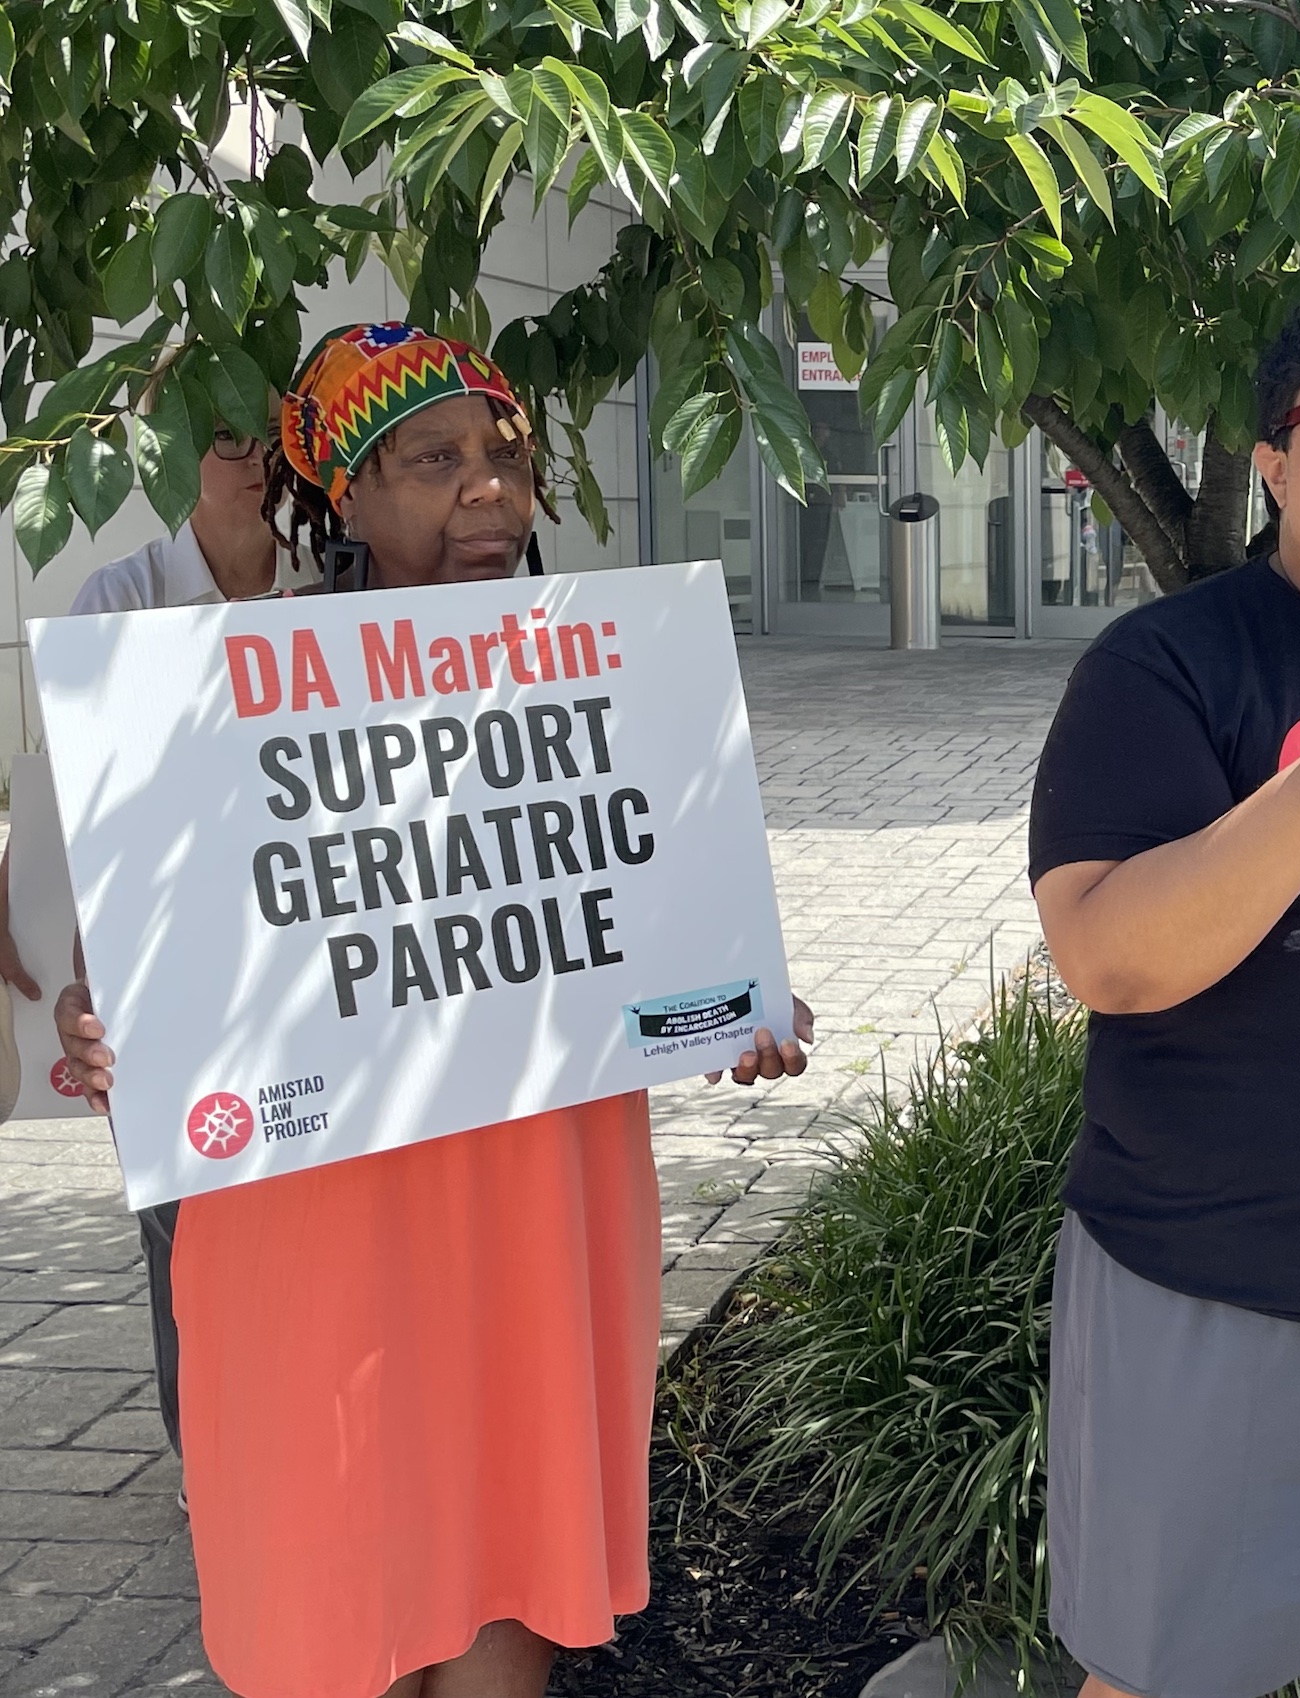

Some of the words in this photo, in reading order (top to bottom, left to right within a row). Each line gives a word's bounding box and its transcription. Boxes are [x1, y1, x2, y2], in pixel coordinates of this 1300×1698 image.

[226, 628, 339, 718] DA
[361, 608, 623, 701] Martin:
[259, 696, 612, 821] SUPPORT
[252, 787, 655, 927] GERIATRIC
[327, 887, 624, 1019] PAROLE
[660, 1024, 673, 1035] BY
[674, 1011, 737, 1034] INCARCERATION
[665, 1013, 702, 1026] ABOLISH
[702, 1004, 729, 1019] DEATH
[643, 1042, 680, 1058] Lehigh
[680, 1034, 712, 1050] Valley
[714, 1025, 755, 1044] Chapter
[258, 1075, 325, 1106] AMISTAD
[260, 1101, 293, 1125] LAW
[263, 1112, 329, 1144] PROJECT
